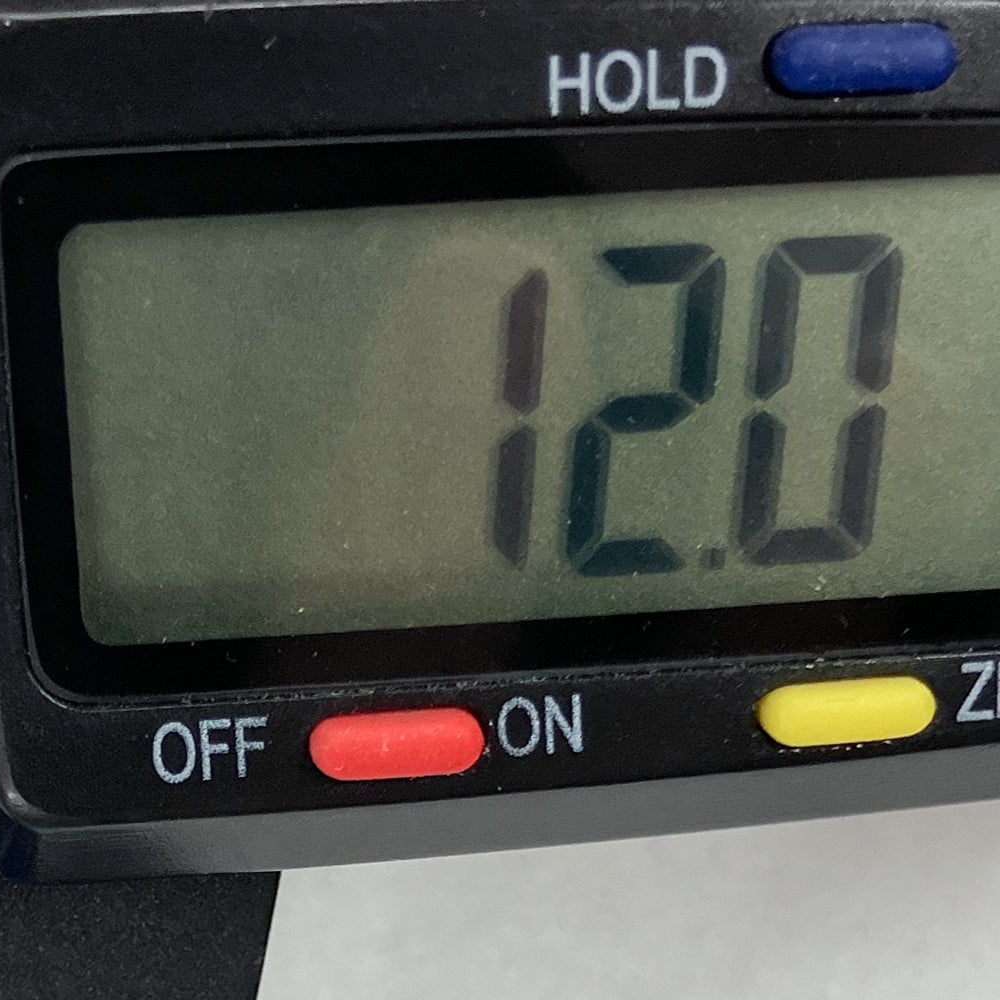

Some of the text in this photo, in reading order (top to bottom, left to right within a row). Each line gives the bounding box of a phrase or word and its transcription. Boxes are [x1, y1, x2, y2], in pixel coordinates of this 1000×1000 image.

[547, 46, 728, 118] HOLD
[490, 234, 903, 578] 12.0
[497, 693, 585, 758] ON
[956, 660, 1000, 723] Z
[151, 713, 270, 785] OFF
